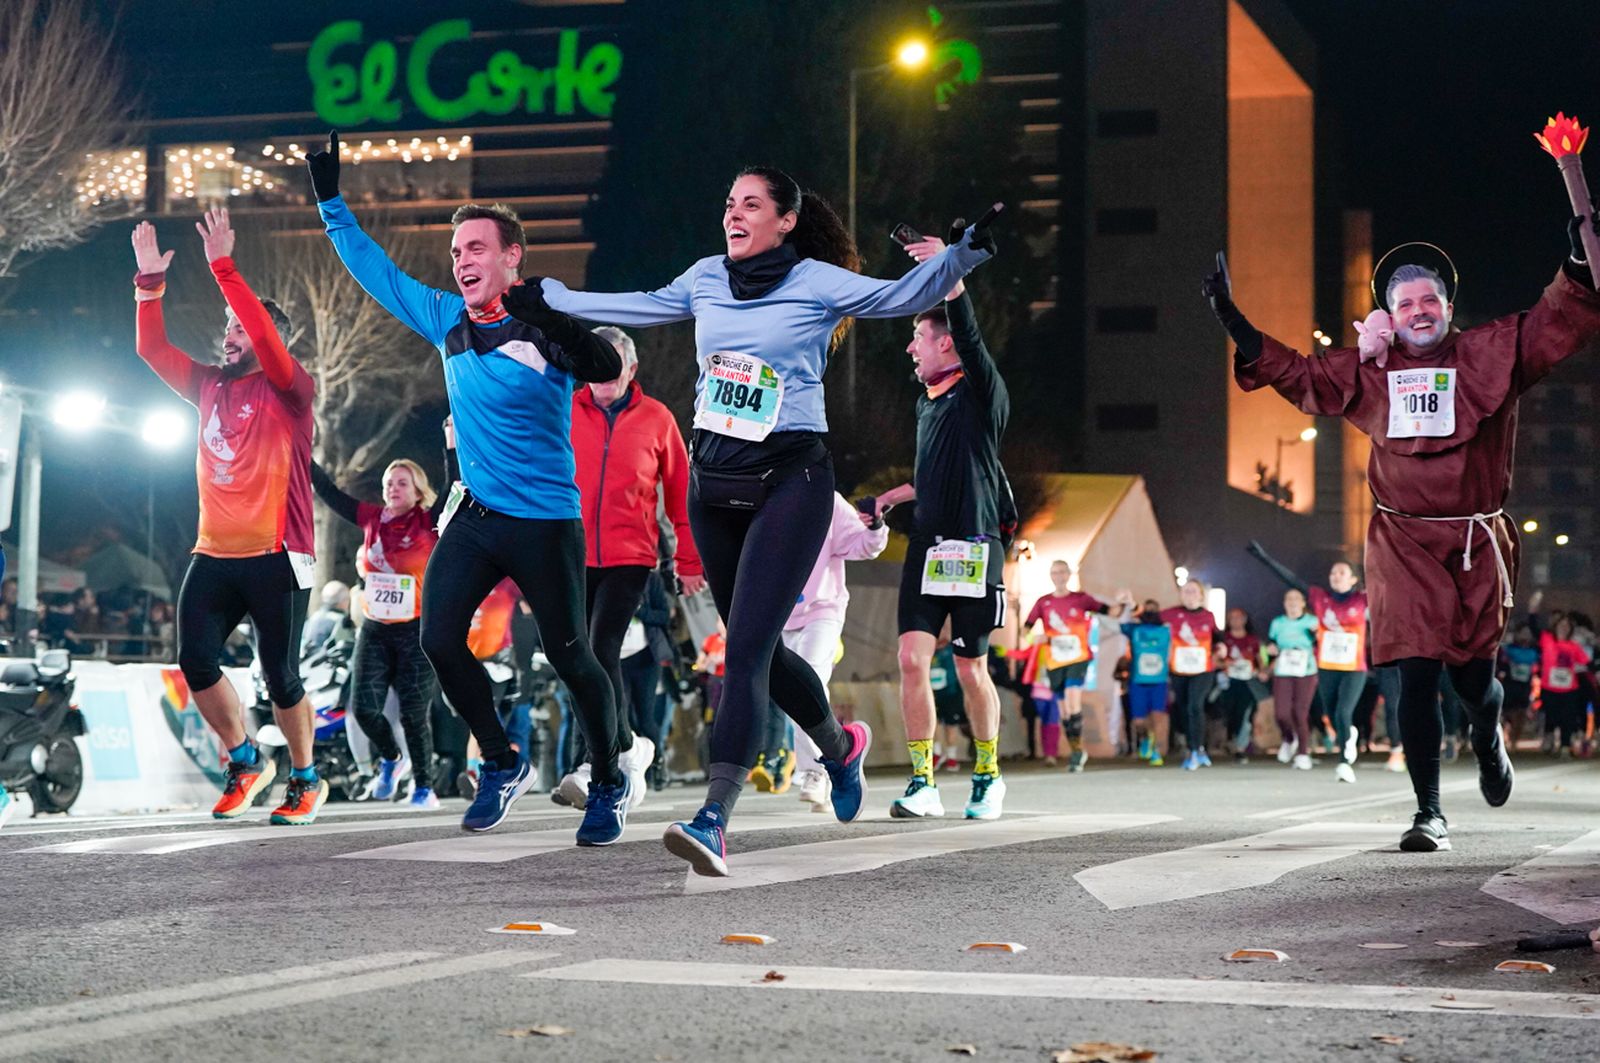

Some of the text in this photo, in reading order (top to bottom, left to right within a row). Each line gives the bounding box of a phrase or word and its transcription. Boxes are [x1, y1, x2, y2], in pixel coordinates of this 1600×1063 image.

[306, 18, 623, 126] El Corte
[713, 367, 725, 377] SAN
[725, 370, 752, 383] ANTÓN
[721, 359, 742, 371] NOCHE
[742, 363, 753, 373] DE
[713, 378, 763, 412] 7894
[1403, 392, 1438, 413] 1018
[934, 560, 976, 578] 4965
[375, 589, 404, 604] 2267
